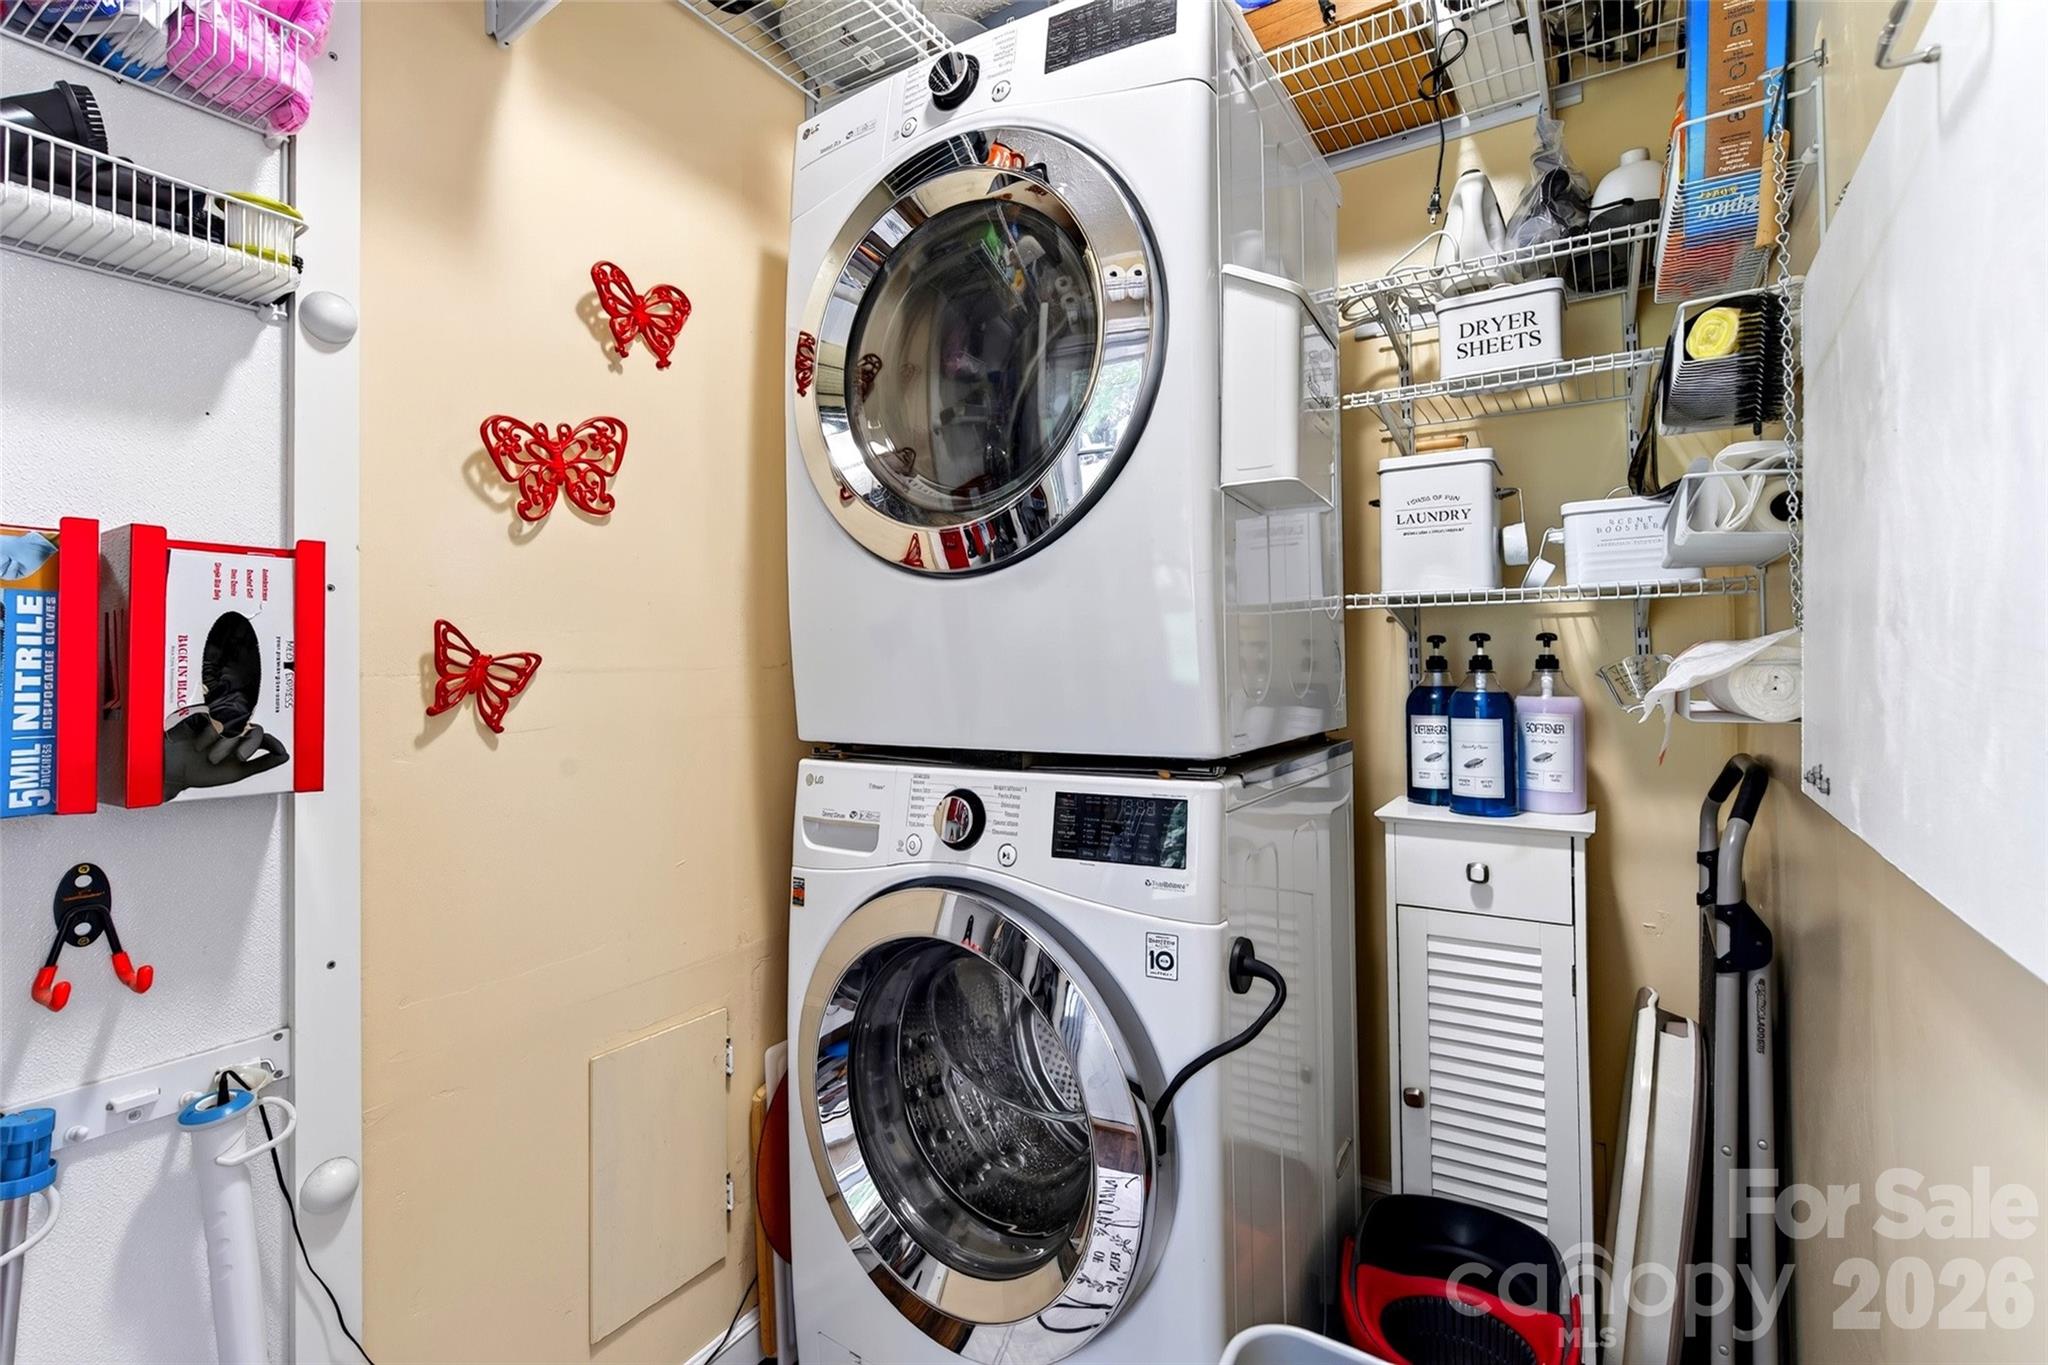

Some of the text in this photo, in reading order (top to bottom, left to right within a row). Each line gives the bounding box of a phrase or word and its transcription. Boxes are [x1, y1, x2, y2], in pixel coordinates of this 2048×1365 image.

[1459, 310, 1539, 339] DRYER
[1456, 329, 1543, 360] SHEETS
[1396, 508, 1472, 526] LAUNDRY
[1595, 522, 1663, 534] BOOSTER
[1608, 515, 1653, 525] SCENT
[12, 594, 44, 732] NITRILE
[42, 595, 57, 730] DISPOSABLE GLOVES
[176, 634, 190, 717] BACK IN BLACK
[1525, 721, 1565, 735] SOFTENER
[1149, 950, 1175, 971] 10
